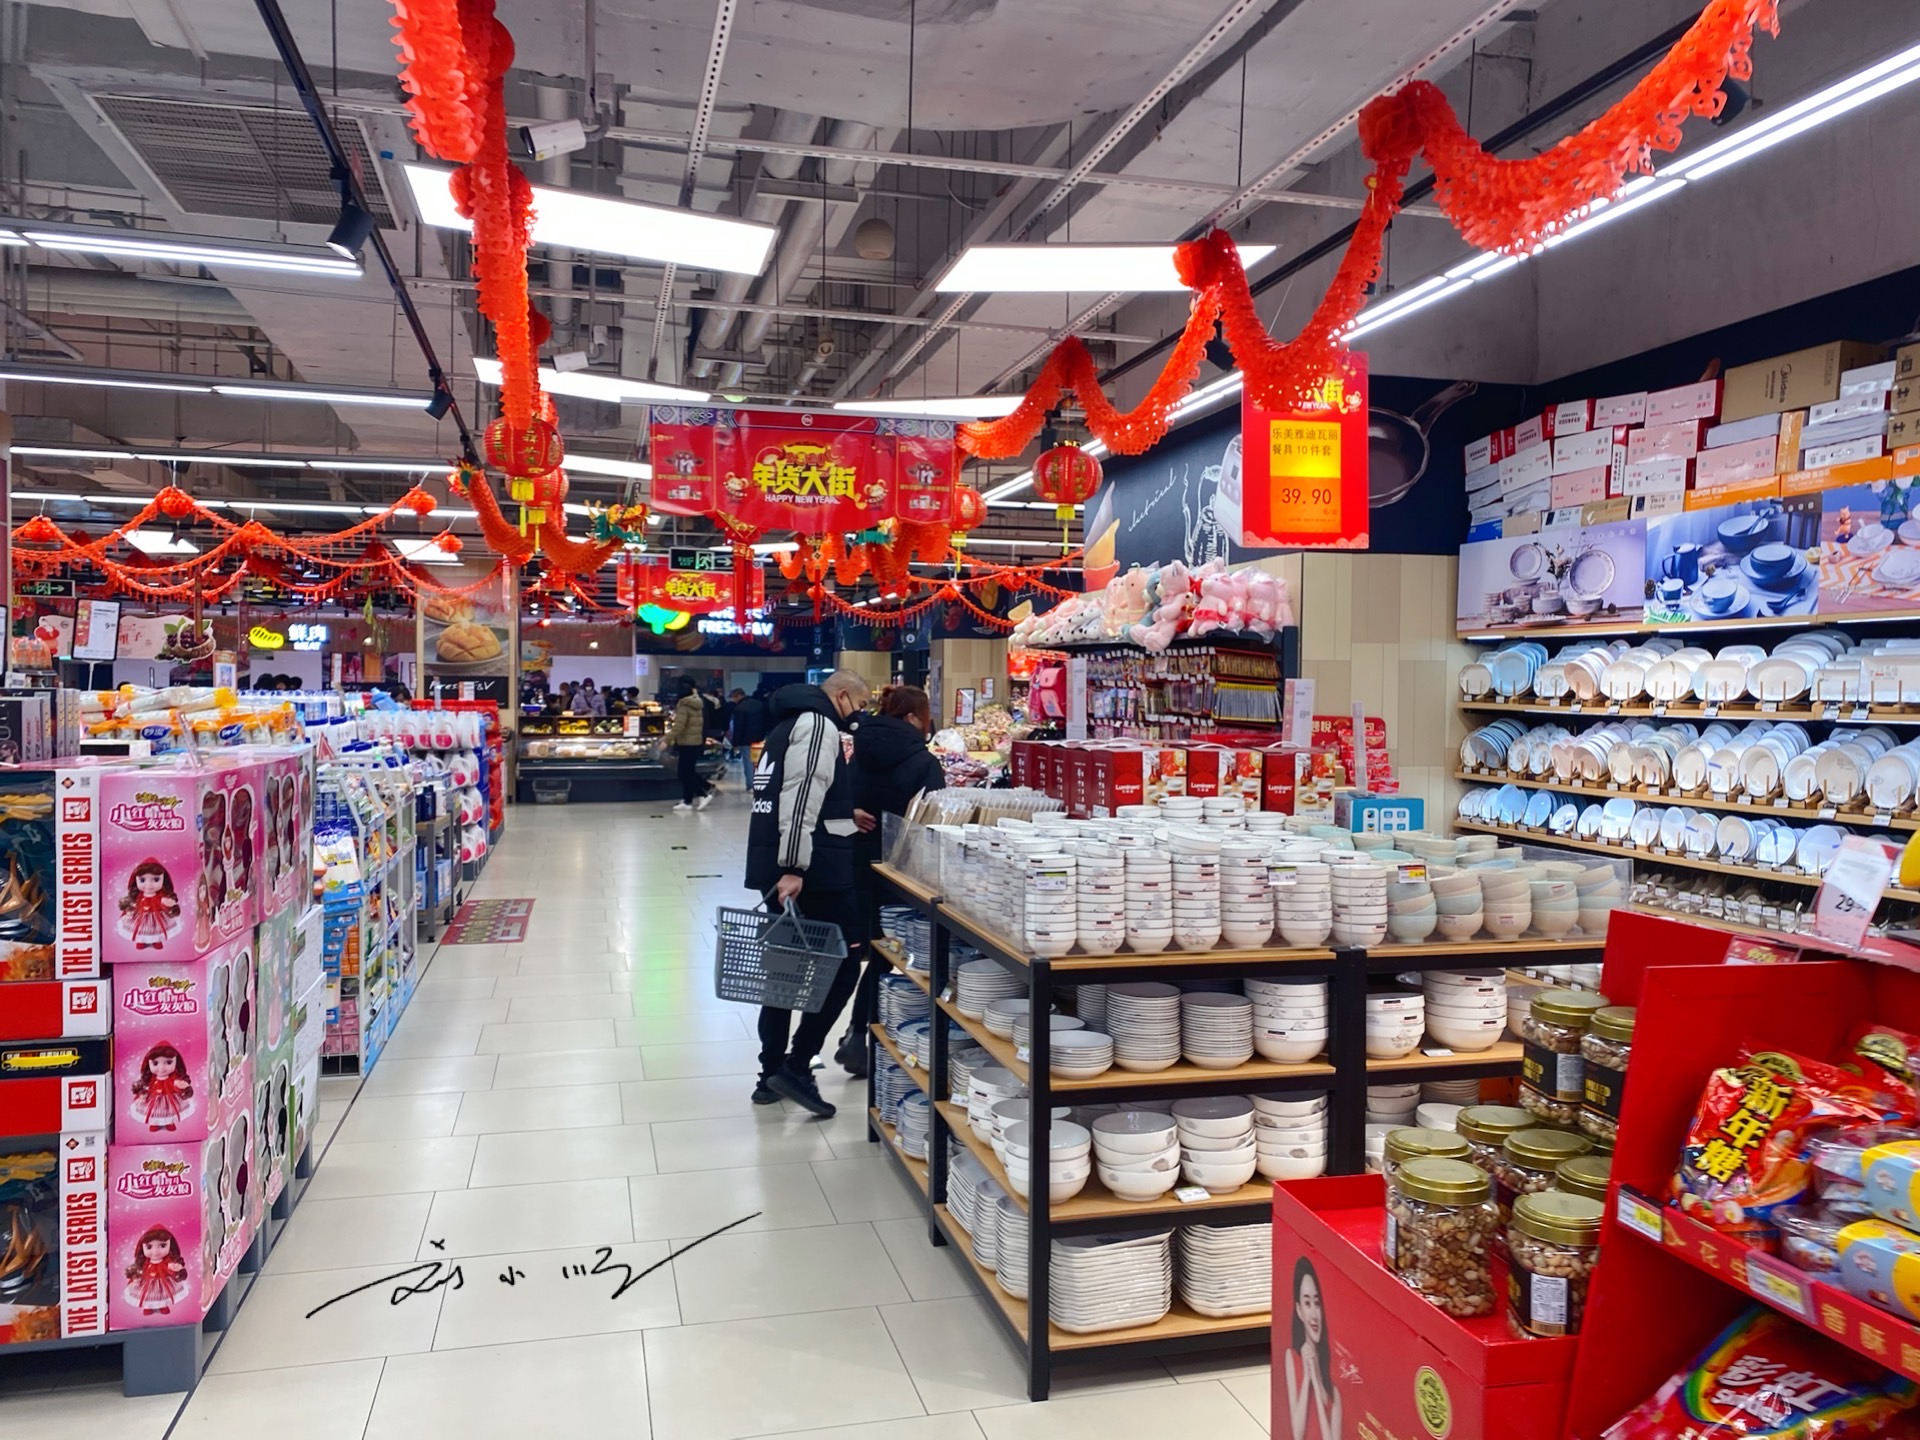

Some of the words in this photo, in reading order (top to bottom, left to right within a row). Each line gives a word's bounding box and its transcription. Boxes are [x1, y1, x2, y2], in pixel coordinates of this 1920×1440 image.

[1779, 363, 1792, 404] Midea
[1271, 427, 1339, 441] 乐美雅迪瓦丽
[752, 461, 857, 497] 年货大街
[1281, 488, 1332, 505] 39.90
[765, 494, 793, 504] HAPPY
[795, 495, 813, 504] NEW
[665, 579, 717, 598] 年货大街
[288, 624, 328, 643] 鲜肉
[63, 832, 93, 885] SERIES
[63, 886, 93, 942] LATEST
[63, 944, 93, 975] THE
[1694, 1076, 1793, 1183] 新年糖
[67, 1191, 98, 1244] SERIES
[67, 1247, 98, 1303] LATEST
[67, 1305, 98, 1335] THE
[1716, 1354, 1852, 1412] 彩虹
